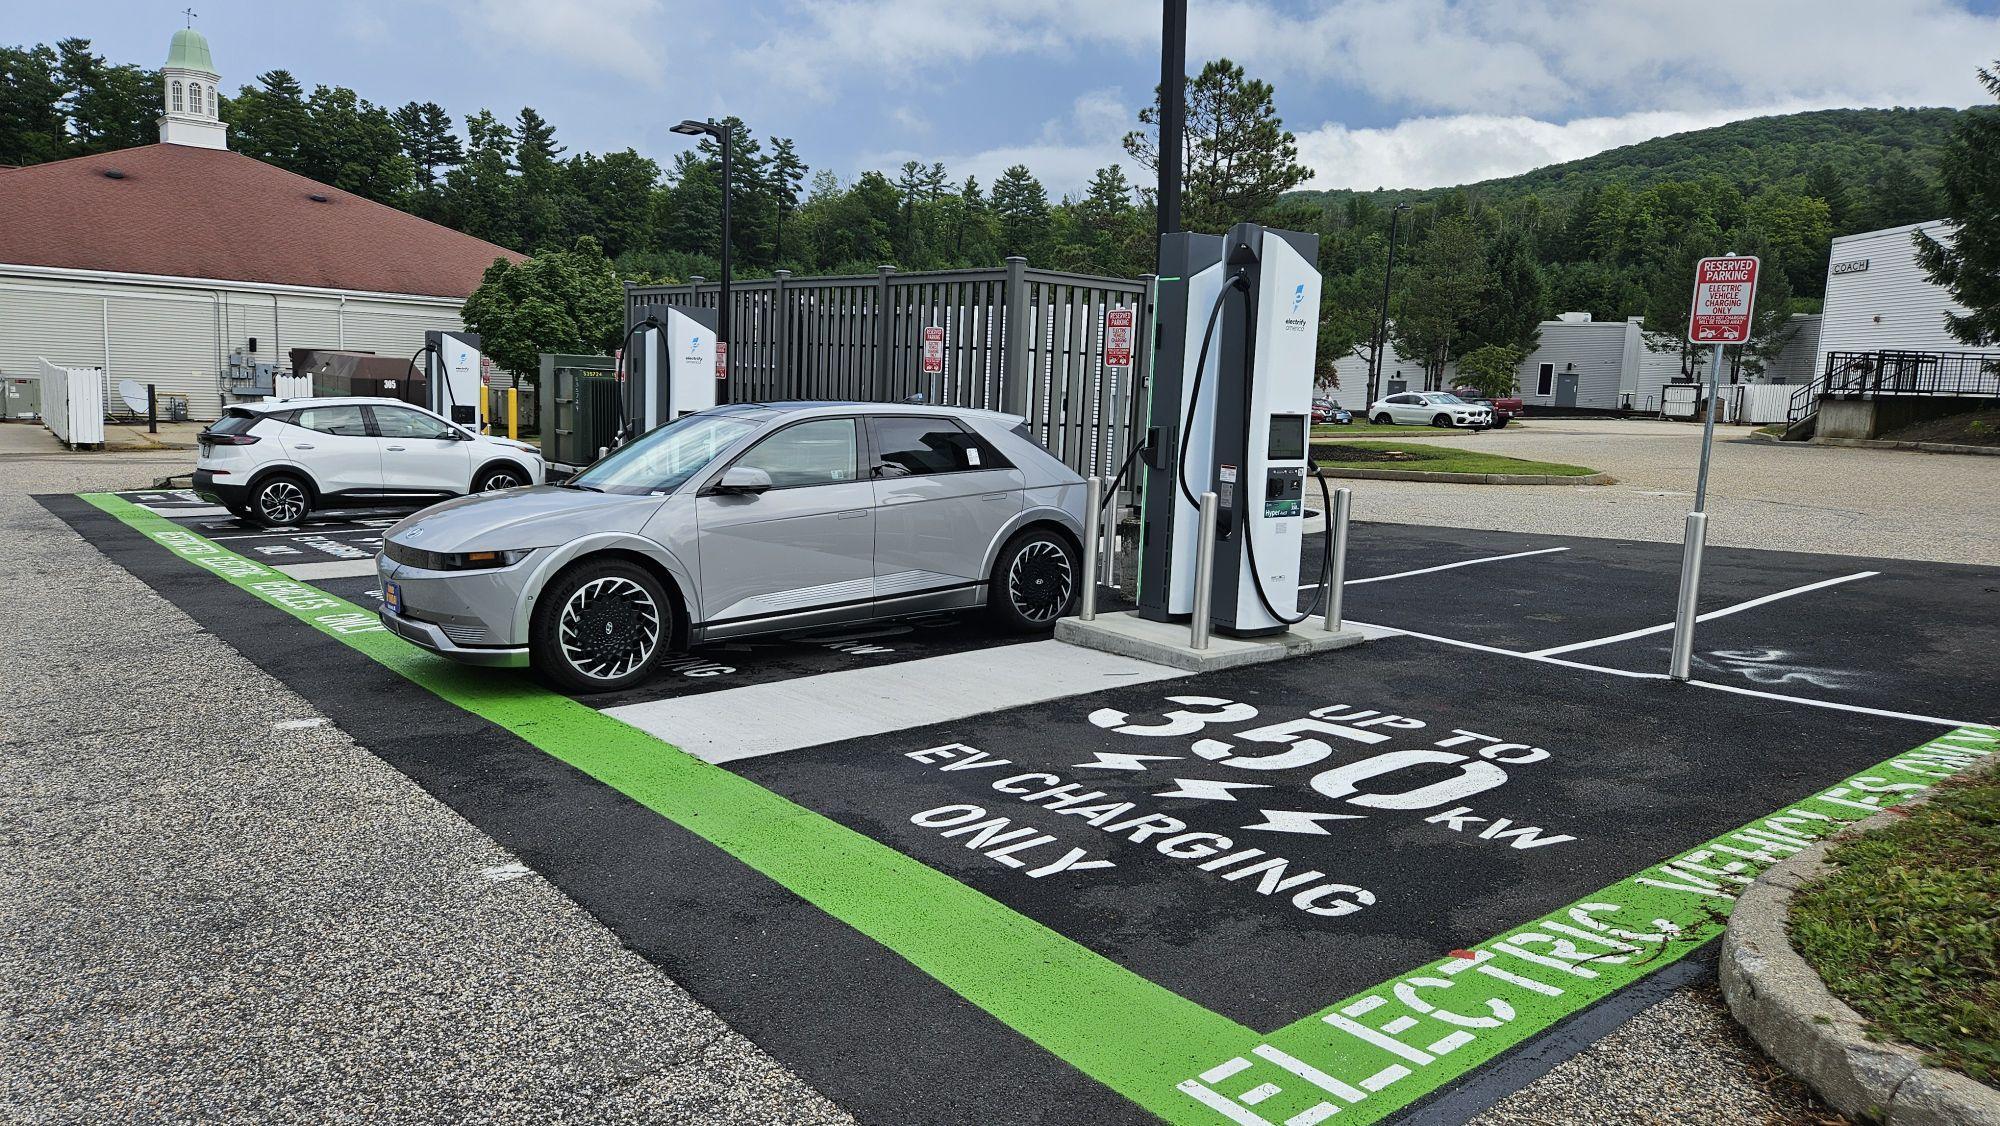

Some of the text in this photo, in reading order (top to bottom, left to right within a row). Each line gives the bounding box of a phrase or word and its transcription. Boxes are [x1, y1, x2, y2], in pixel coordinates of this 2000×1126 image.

[1704, 260, 1753, 271] RESERVED
[1706, 271, 1748, 280] PARKING
[1834, 262, 1865, 273] COACH
[1285, 318, 1306, 326] electrify
[384, 380, 396, 389] 305
[1309, 704, 1551, 764] UP TO
[1088, 695, 1508, 810] 350
[903, 742, 1377, 917] EV CHARGING
[909, 804, 1116, 879] ONLY
[1176, 902, 1682, 1126] ELECTRIC
